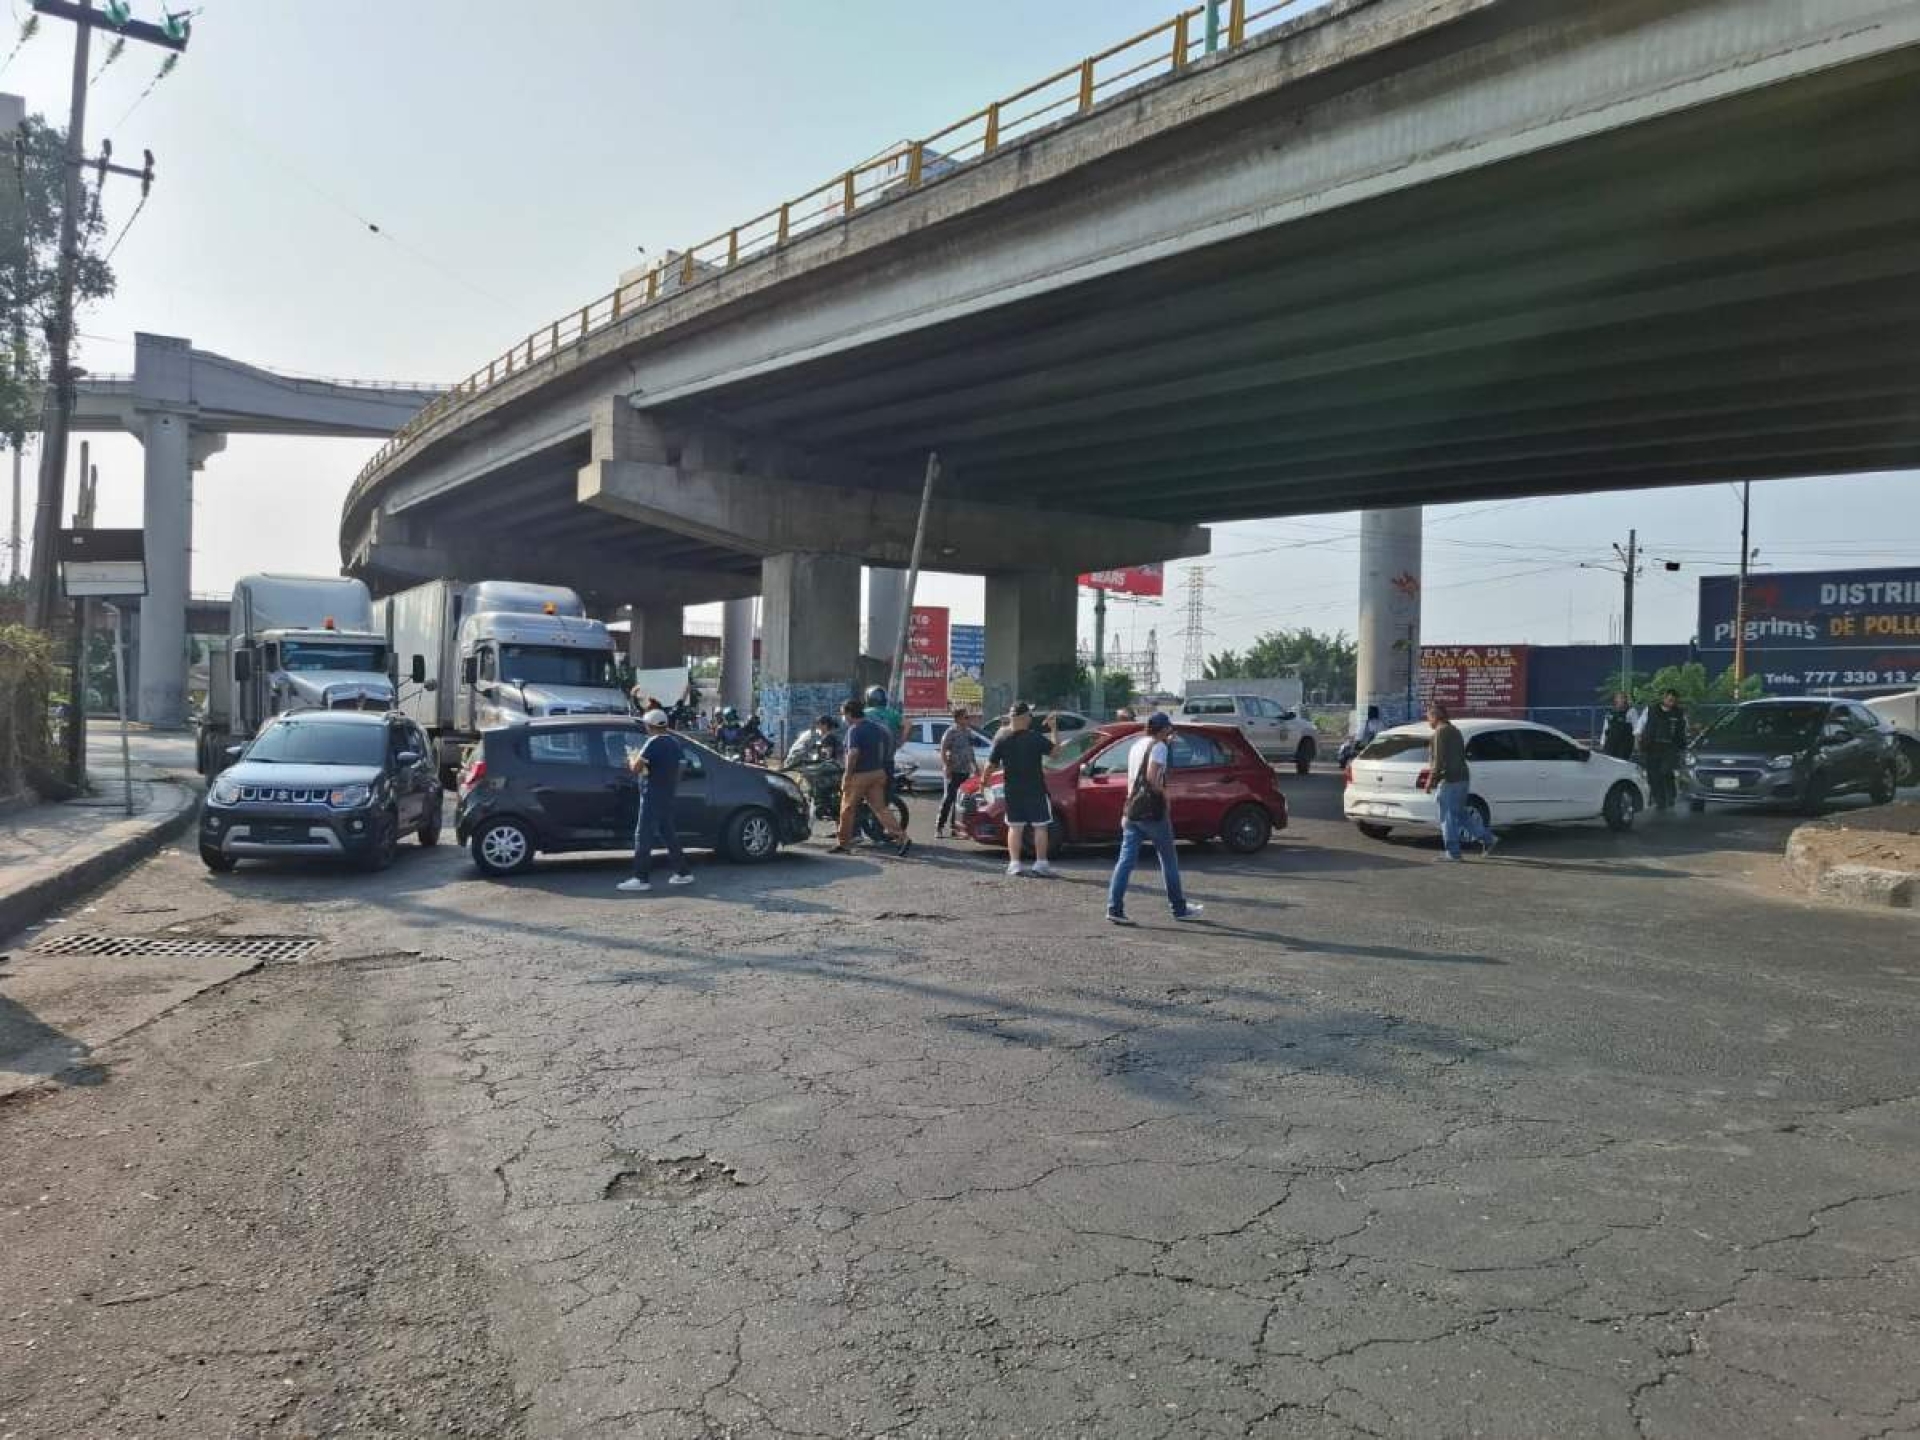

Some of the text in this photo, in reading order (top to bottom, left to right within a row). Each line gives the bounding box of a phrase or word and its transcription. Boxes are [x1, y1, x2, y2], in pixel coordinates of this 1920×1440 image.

[1714, 616, 1818, 642] Pigrim's
[1830, 615, 1856, 636] DE
[1421, 647, 1512, 658] ENTA DE
[1804, 671, 1837, 683] 777
[1843, 671, 1877, 683] 330
[1883, 671, 1906, 683] 13
